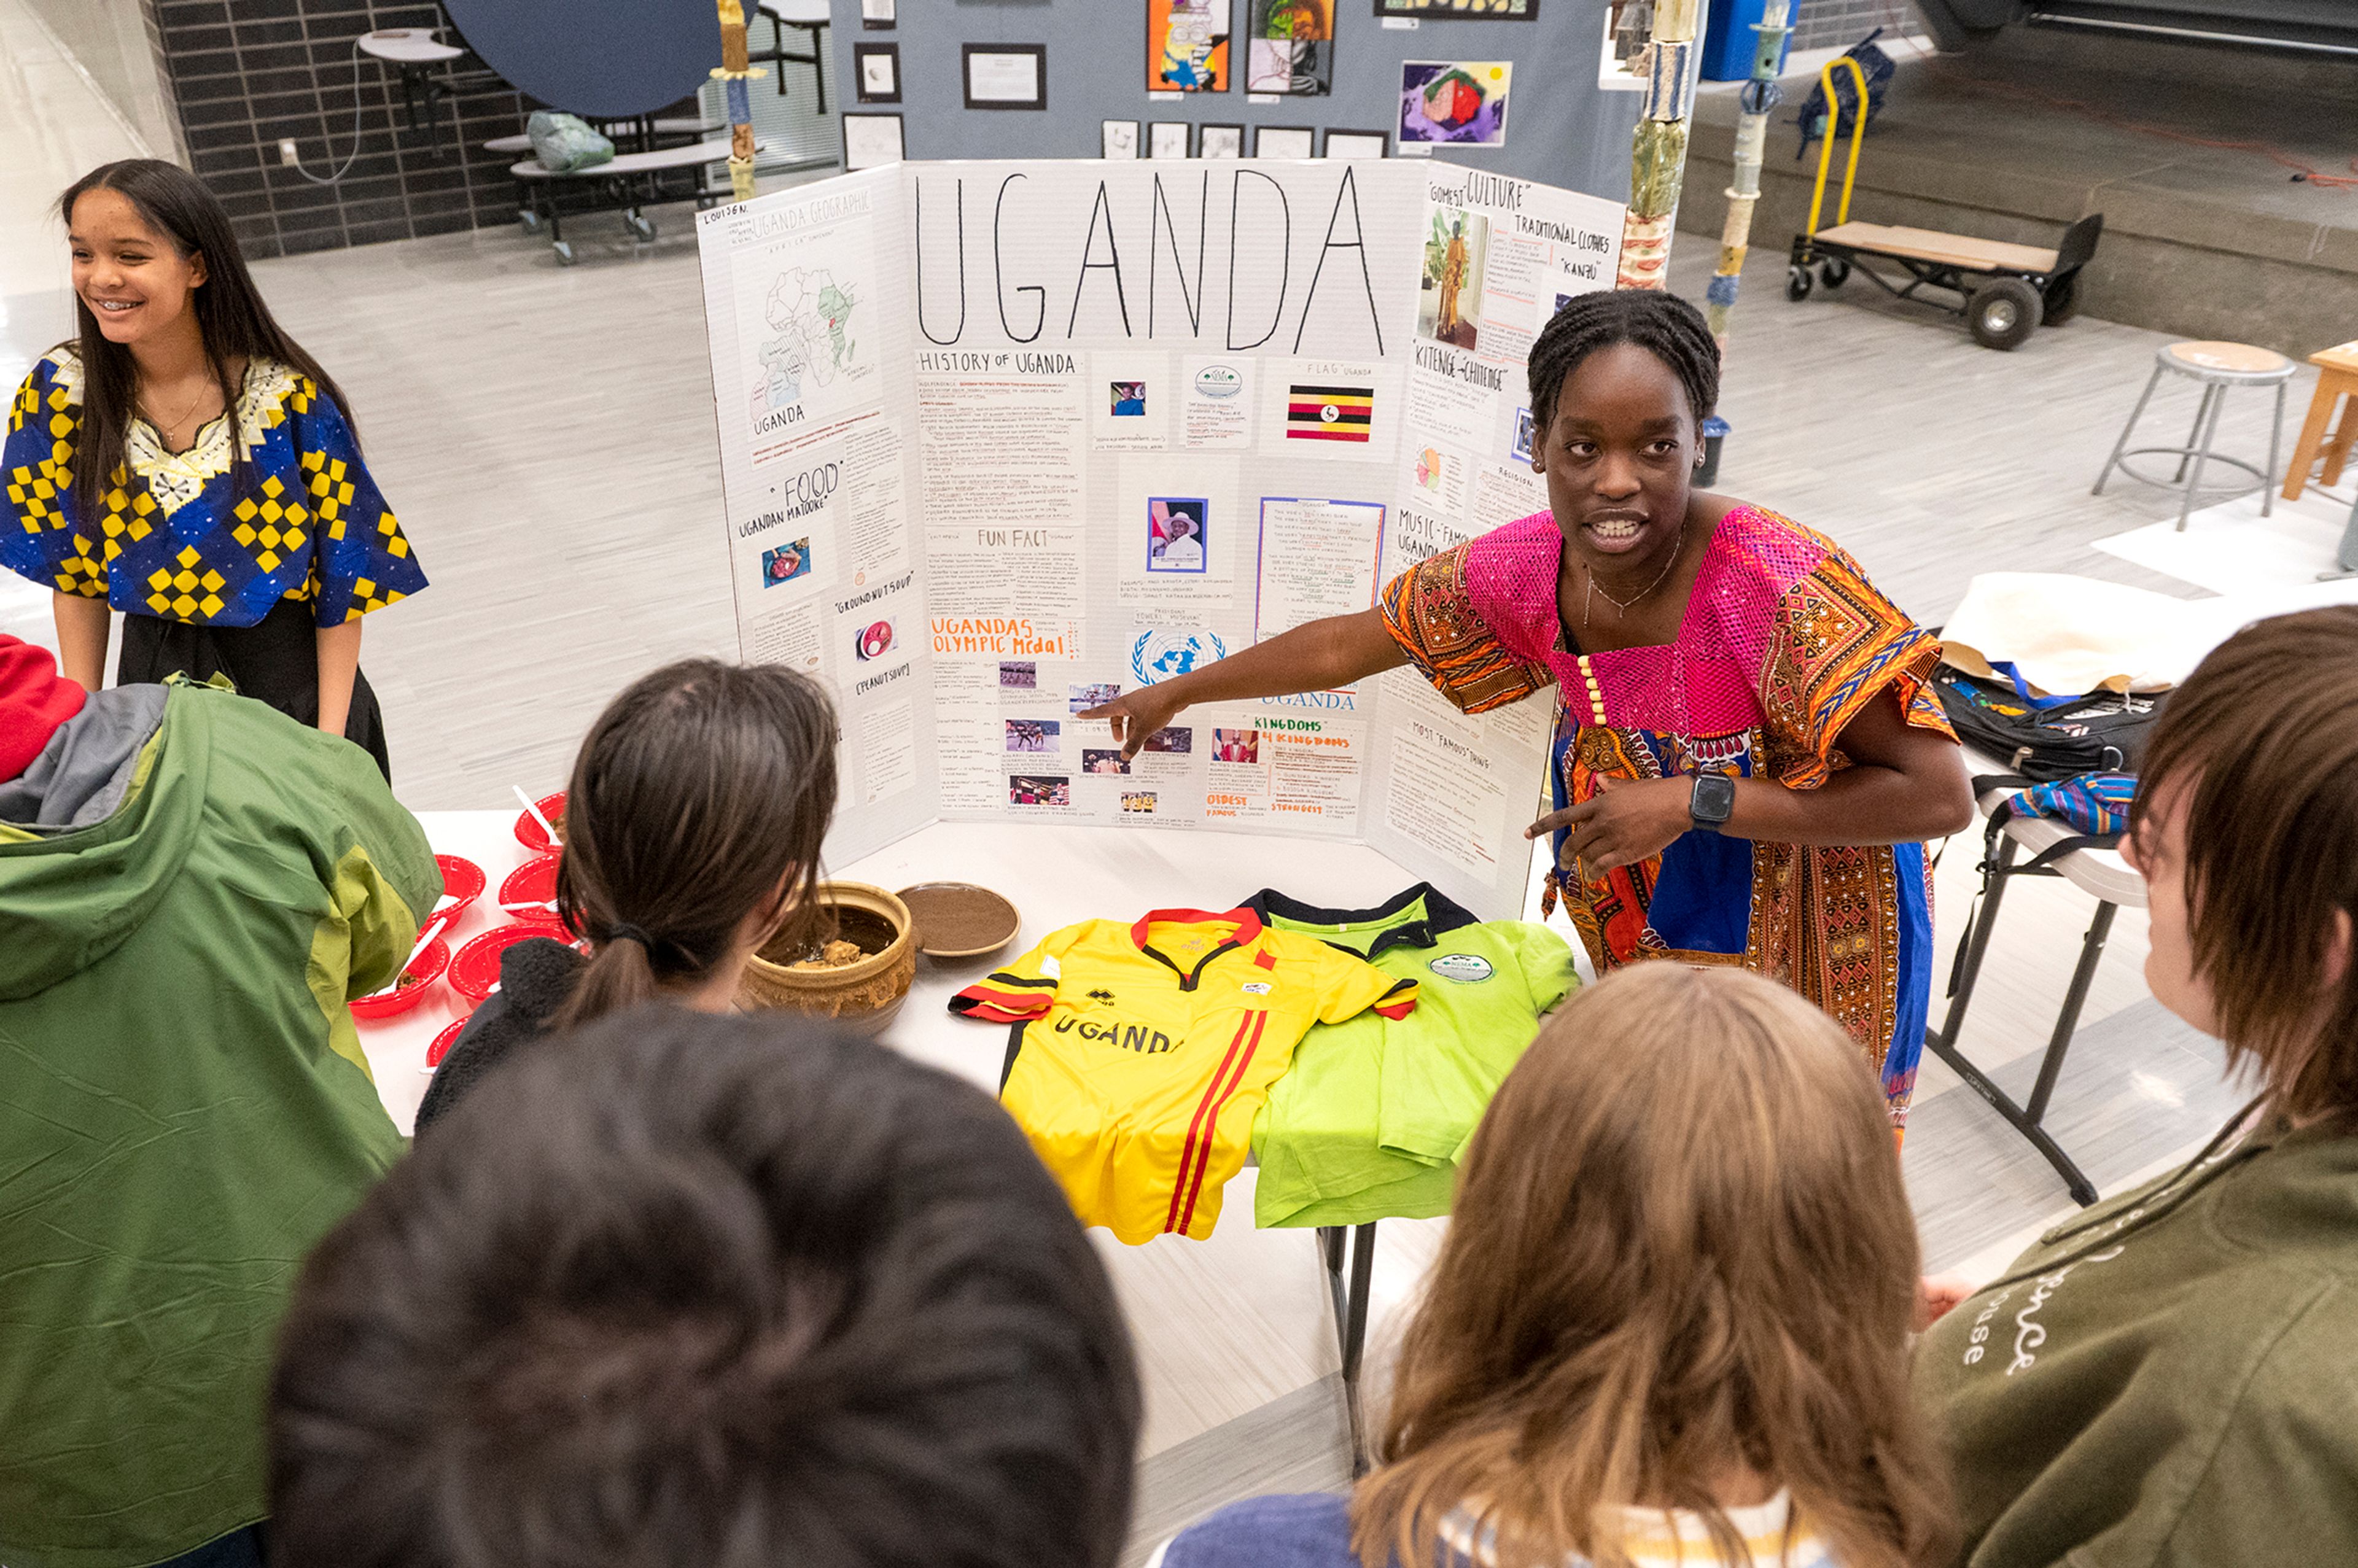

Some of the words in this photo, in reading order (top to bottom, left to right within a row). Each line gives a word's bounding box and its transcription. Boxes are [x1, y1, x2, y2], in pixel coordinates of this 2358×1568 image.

[753, 207, 806, 239] UGANDA
[810, 190, 870, 223] GEOGRAPHIC
[1516, 215, 1576, 246] TRADITIONAL
[916, 165, 1383, 355] UGANDA
[920, 352, 989, 371] HISTORY
[995, 354, 1009, 367] OF
[1016, 352, 1076, 374] UGANDA
[754, 404, 805, 435] UGANDA
[1498, 467, 1533, 487] RELIGION
[739, 511, 784, 537] UGANDAN
[1399, 508, 1434, 540] MUSIC
[978, 530, 1006, 546] FUN
[1013, 530, 1048, 547] FACT
[931, 618, 1033, 638] UGANDAS
[933, 635, 1005, 653] OLYMPIC
[1261, 693, 1355, 710] UGANDA
[1263, 731, 1272, 743] 4
[1277, 733, 1349, 748] KINGDOMS
[1412, 721, 1433, 740] MOST
[1271, 803, 1323, 814] STRONGEST
